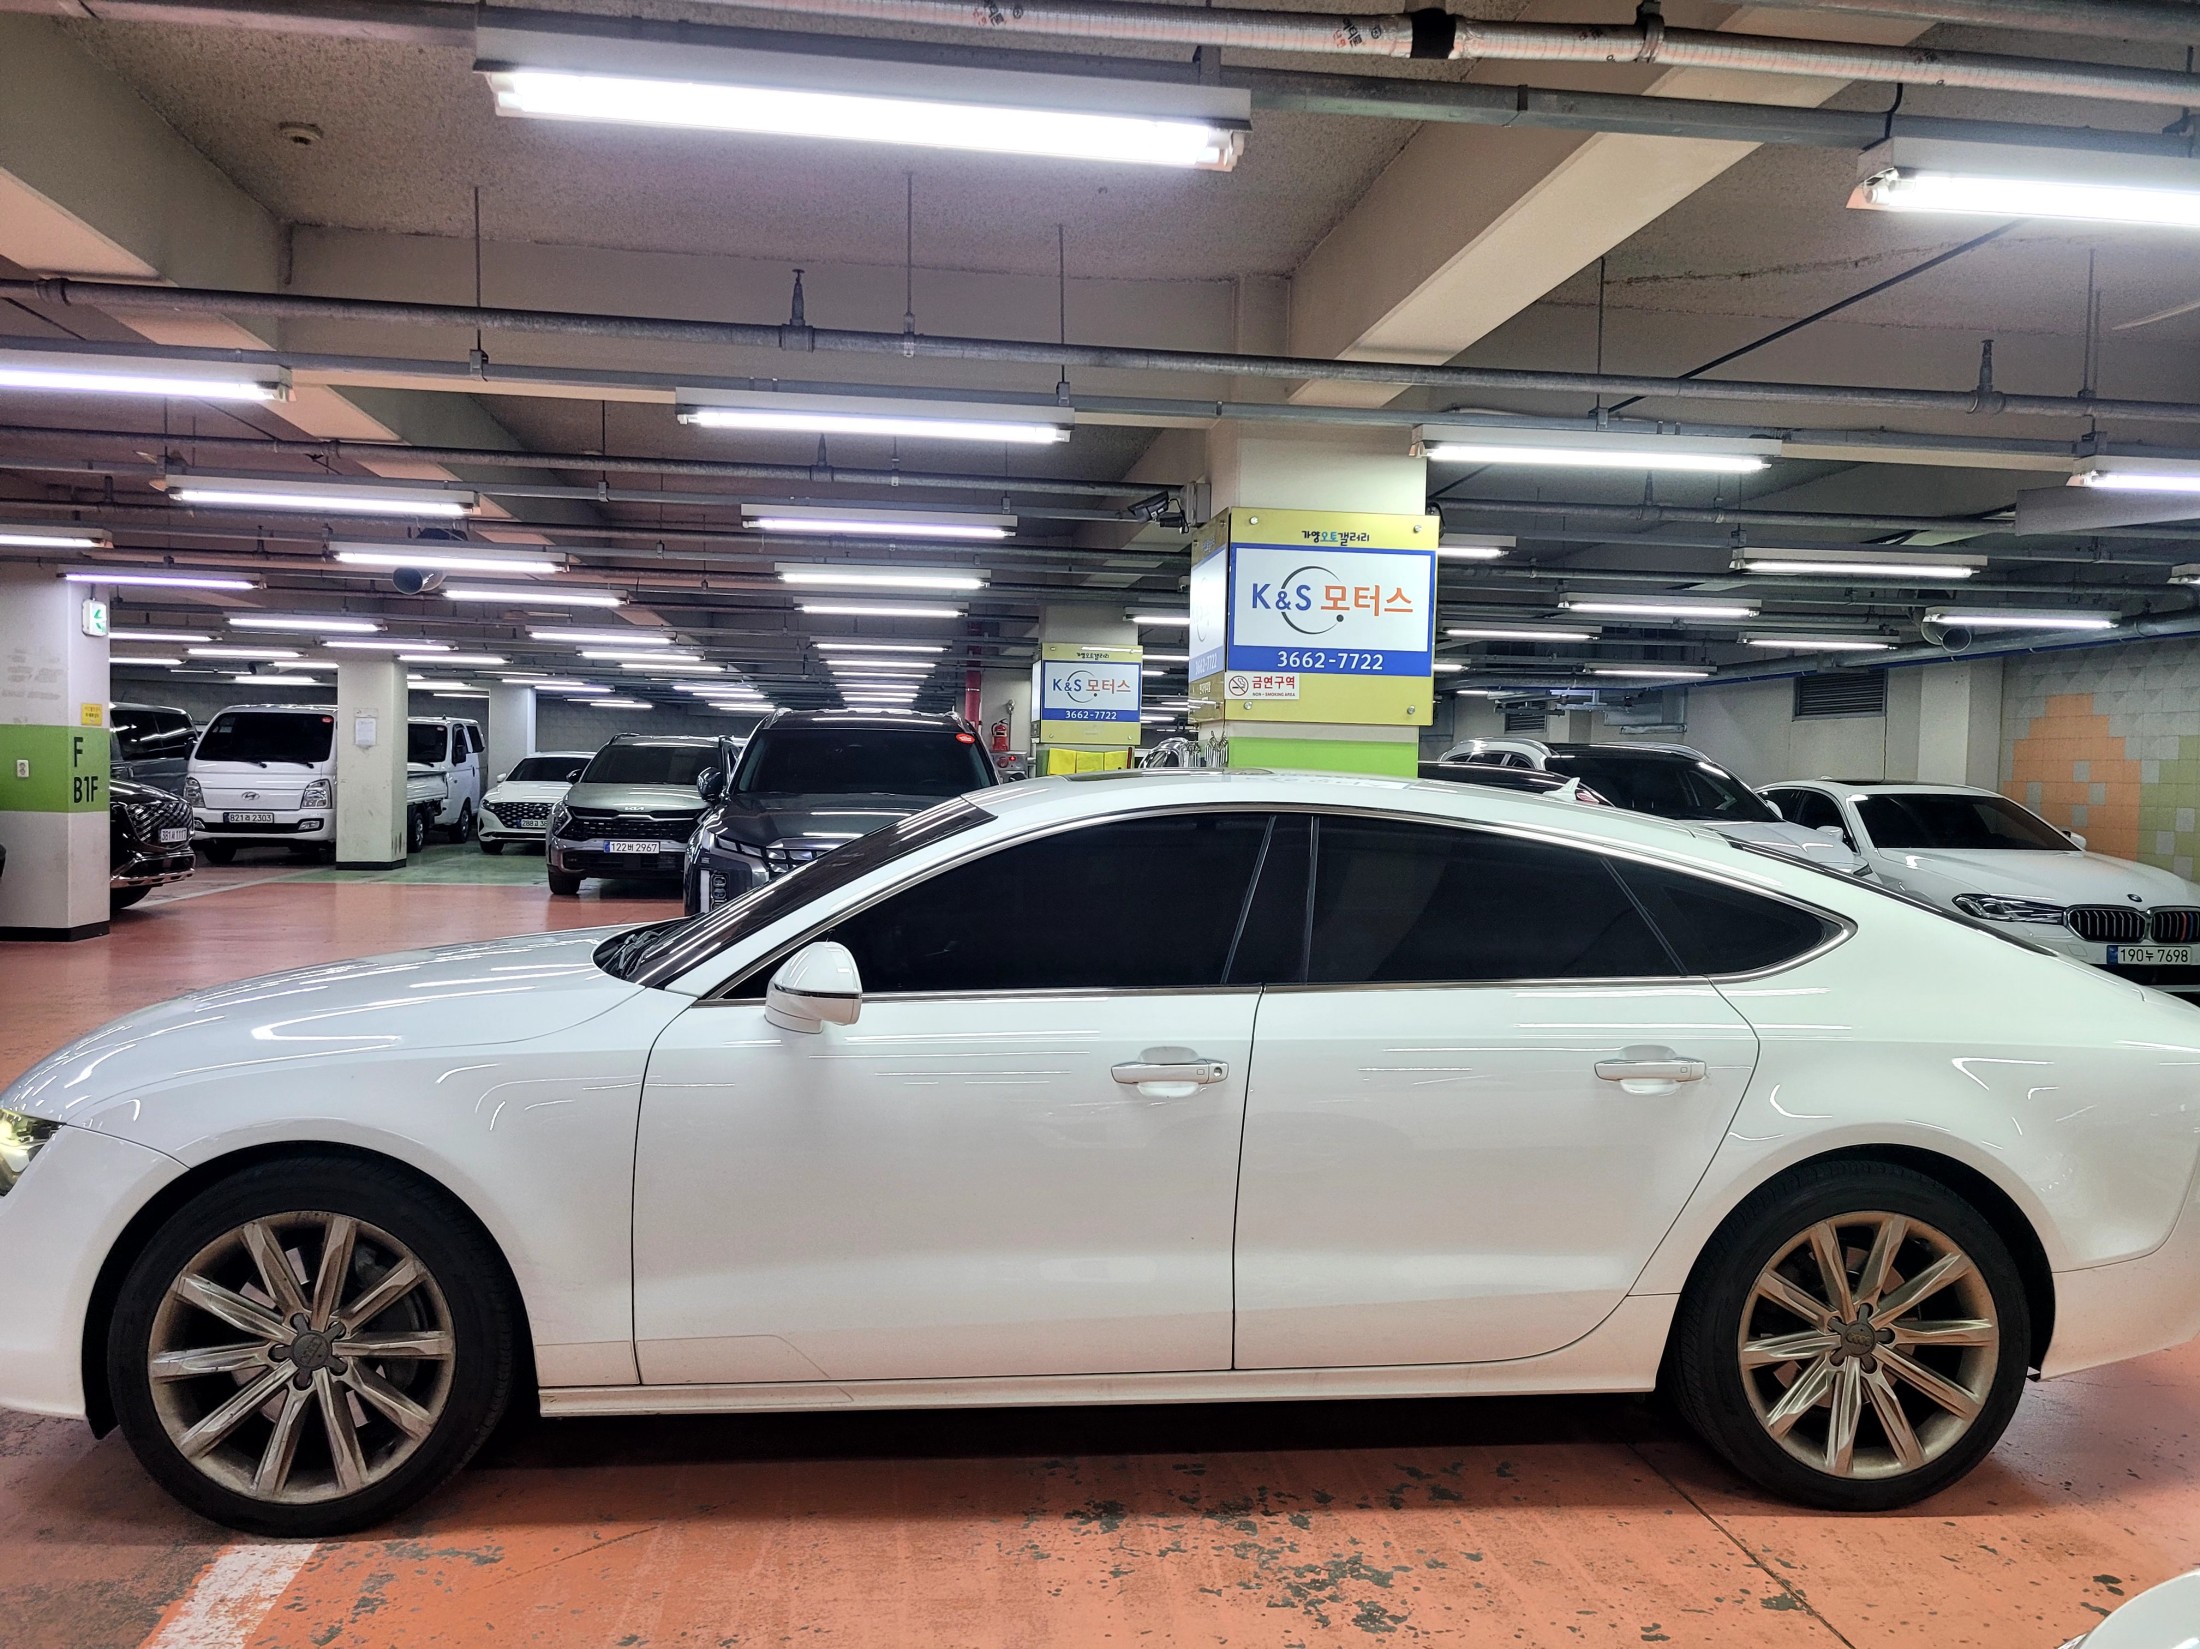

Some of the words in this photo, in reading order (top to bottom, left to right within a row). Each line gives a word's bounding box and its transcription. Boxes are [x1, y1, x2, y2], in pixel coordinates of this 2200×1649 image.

[1302, 531, 1370, 546] 가양오토갤러리
[1252, 583, 1311, 610] K&S
[1321, 585, 1413, 616] 모터스
[1277, 651, 1383, 670] 3662-7722
[1053, 678, 1082, 692] K&S
[1086, 679, 1131, 694] 모터스
[1252, 676, 1295, 689] 금연구역
[1065, 711, 1117, 720] 3662-7722
[74, 737, 84, 767] F
[74, 776, 98, 803] B1F
[636, 843, 657, 852] 2967
[2120, 948, 2154, 962] 190누
[2157, 949, 2188, 962] 7698
